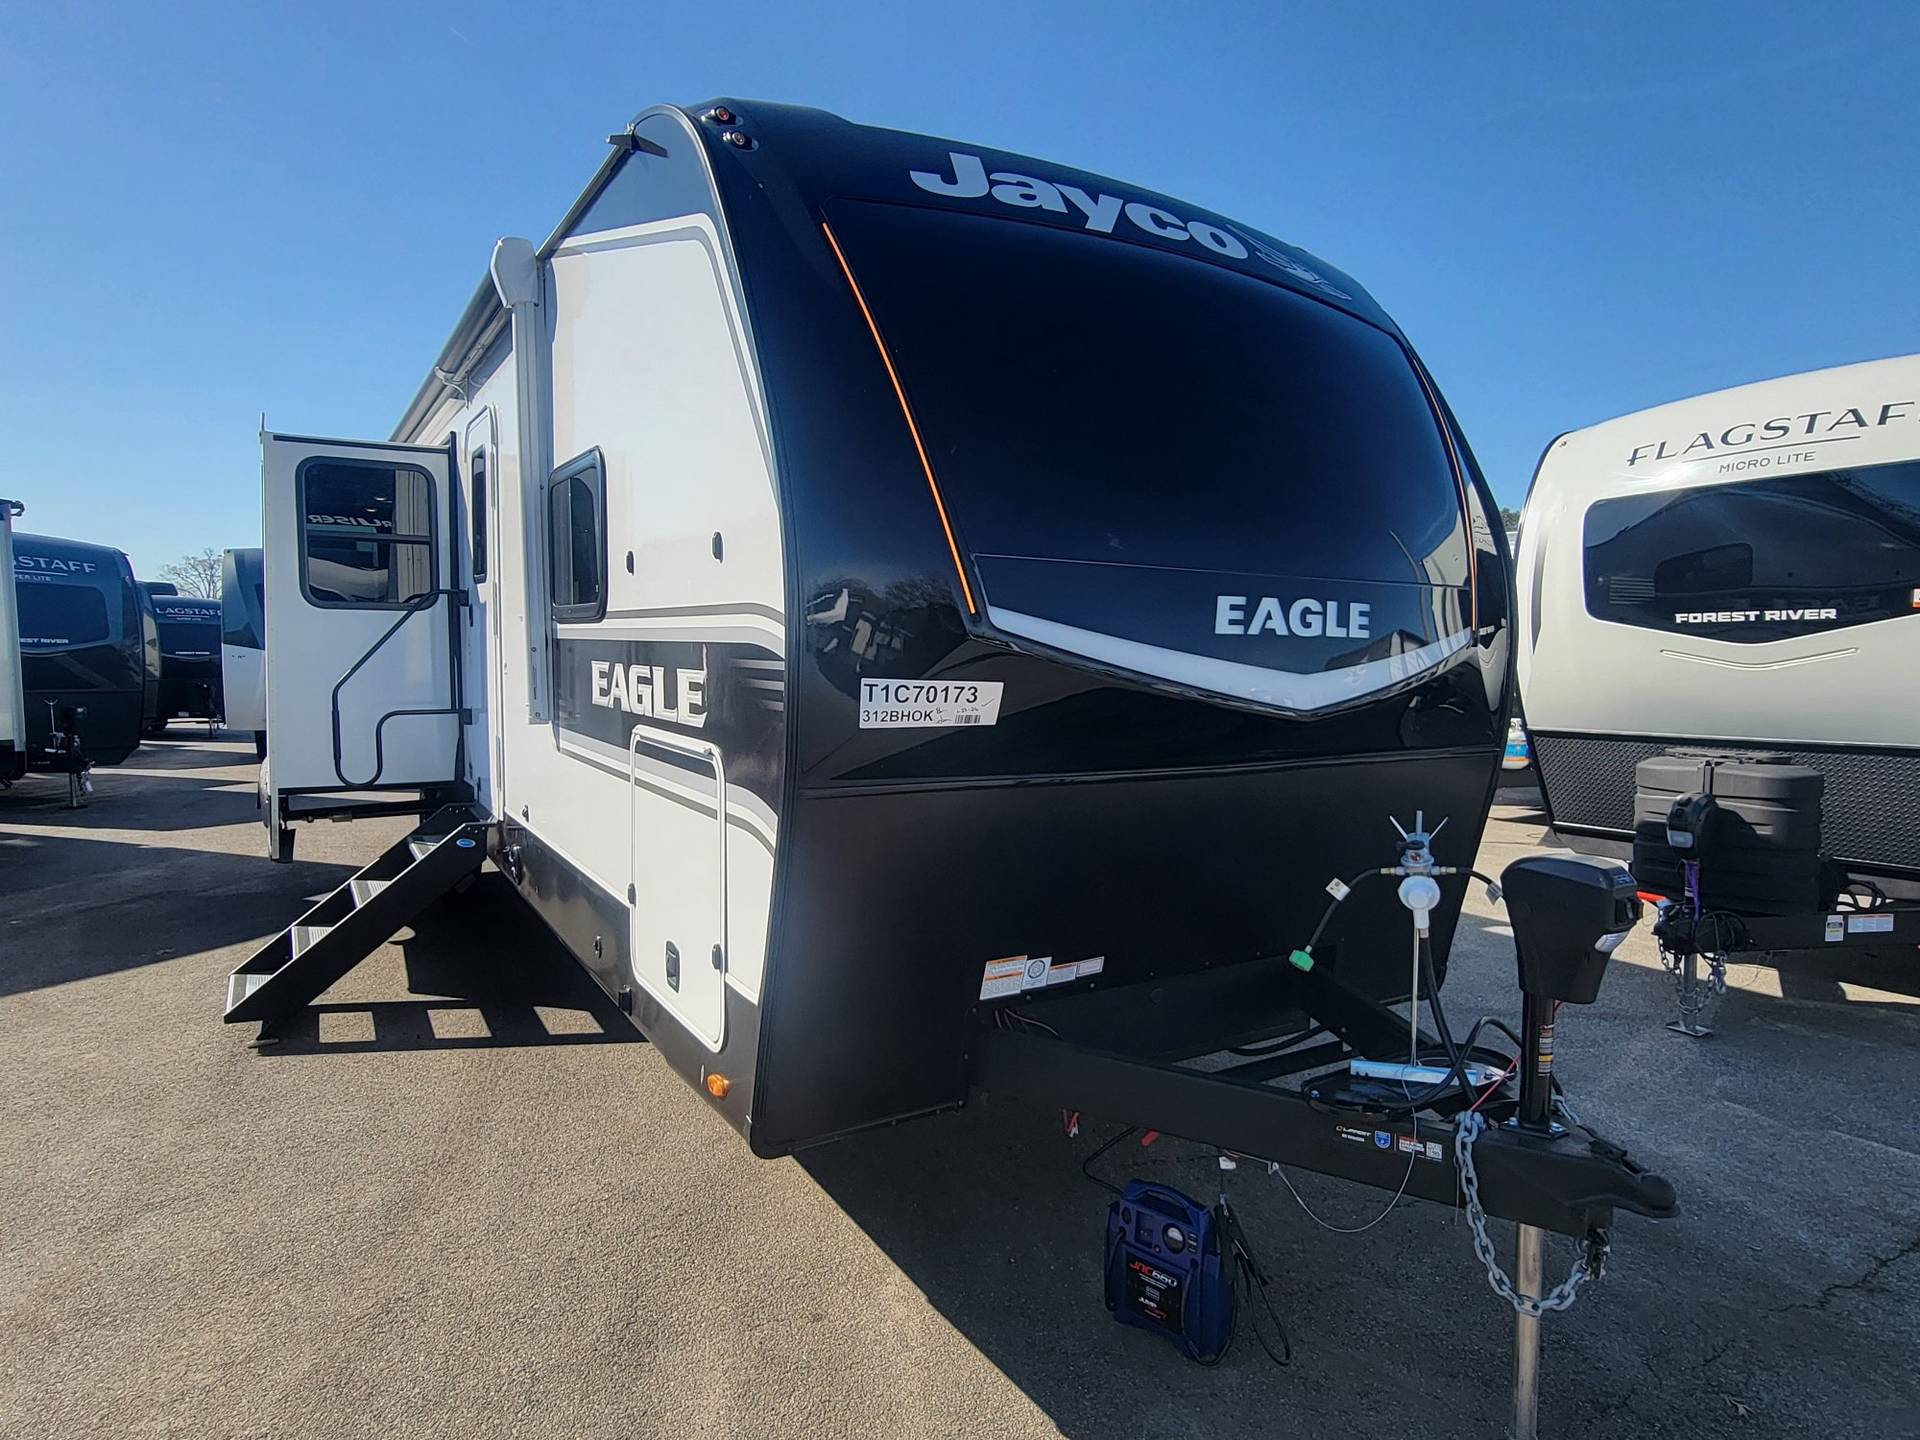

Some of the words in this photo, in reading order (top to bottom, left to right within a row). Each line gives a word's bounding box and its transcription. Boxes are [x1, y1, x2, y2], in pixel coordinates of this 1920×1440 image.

[909, 151, 1249, 260] Jayco
[1626, 401, 1920, 466] FLAGSTAF
[1719, 457, 1771, 473] MICRO
[1777, 451, 1817, 464] LITE
[14, 555, 97, 574] STAFF
[1214, 595, 1371, 639] EAGLE
[1675, 610, 1761, 624] FOREST
[1765, 608, 1837, 621] RIVER
[591, 660, 708, 728] EAGLE
[863, 683, 978, 704] T1C70173
[862, 709, 934, 723] 312BHOK
